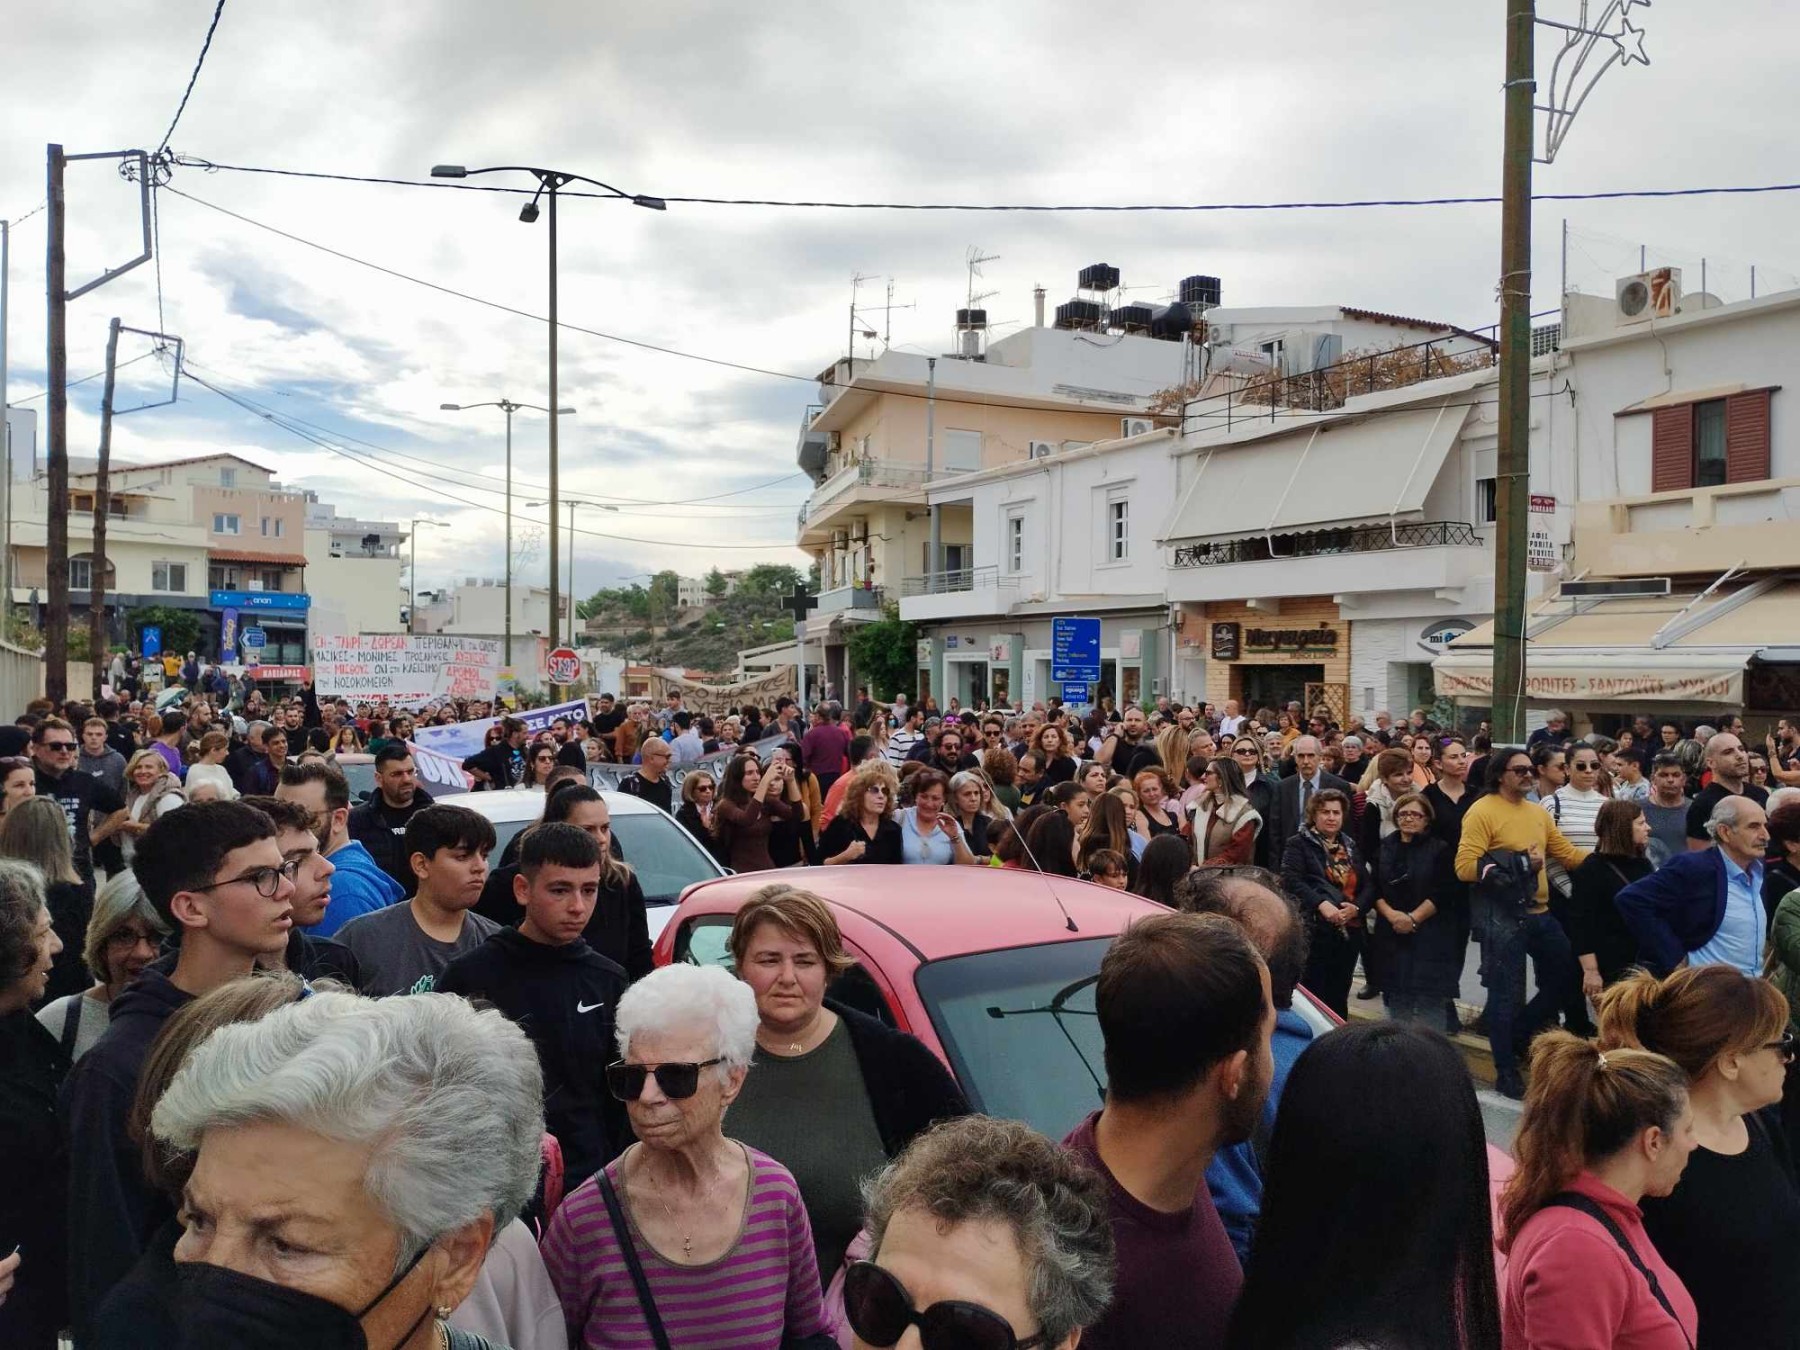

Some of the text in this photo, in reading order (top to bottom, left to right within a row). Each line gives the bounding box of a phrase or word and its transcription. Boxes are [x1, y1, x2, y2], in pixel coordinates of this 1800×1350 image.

[1529, 540, 1553, 549] ΡΟΠΙΤΑ
[357, 651, 398, 662] ΜΟΝΙΜΕΣ
[1525, 677, 1577, 694] ΡΟΠΙΤΕΣ
